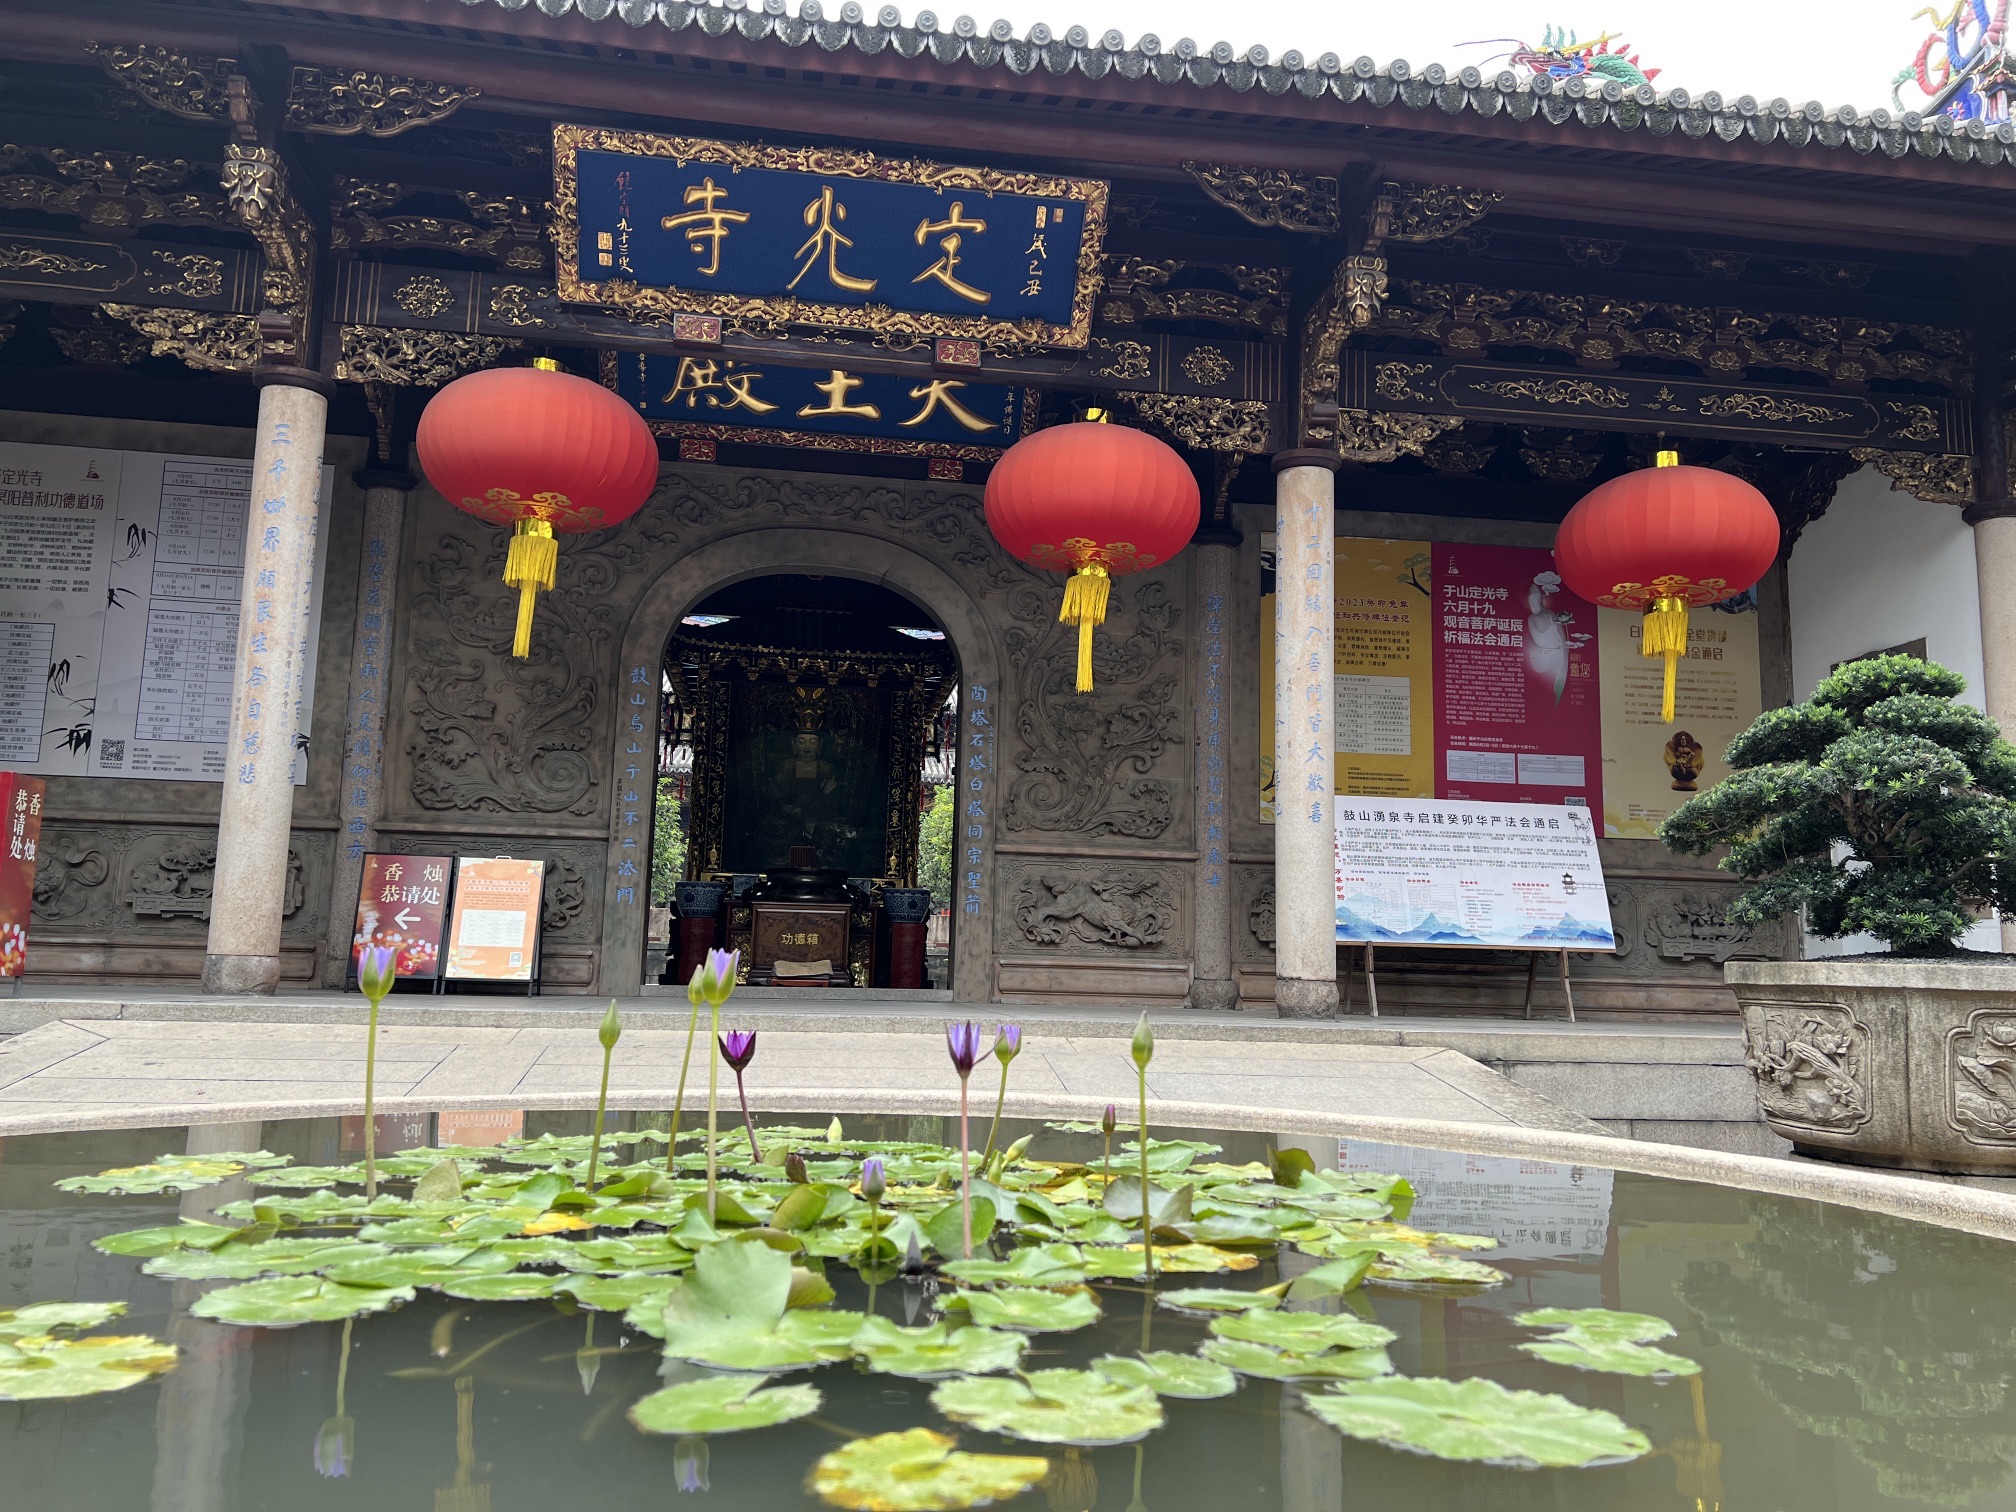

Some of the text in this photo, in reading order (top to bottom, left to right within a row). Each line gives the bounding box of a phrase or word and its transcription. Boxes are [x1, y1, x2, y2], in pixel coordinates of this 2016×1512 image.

[1443, 585, 1508, 600] 于山定光寺
[1443, 600, 1496, 615] 六月十九
[1444, 615, 1523, 632] 观音菩萨诞辰
[1444, 630, 1523, 647] 祈福法会通启
[380, 885, 441, 905] 恭请处
[781, 932, 819, 945] 功德箱
